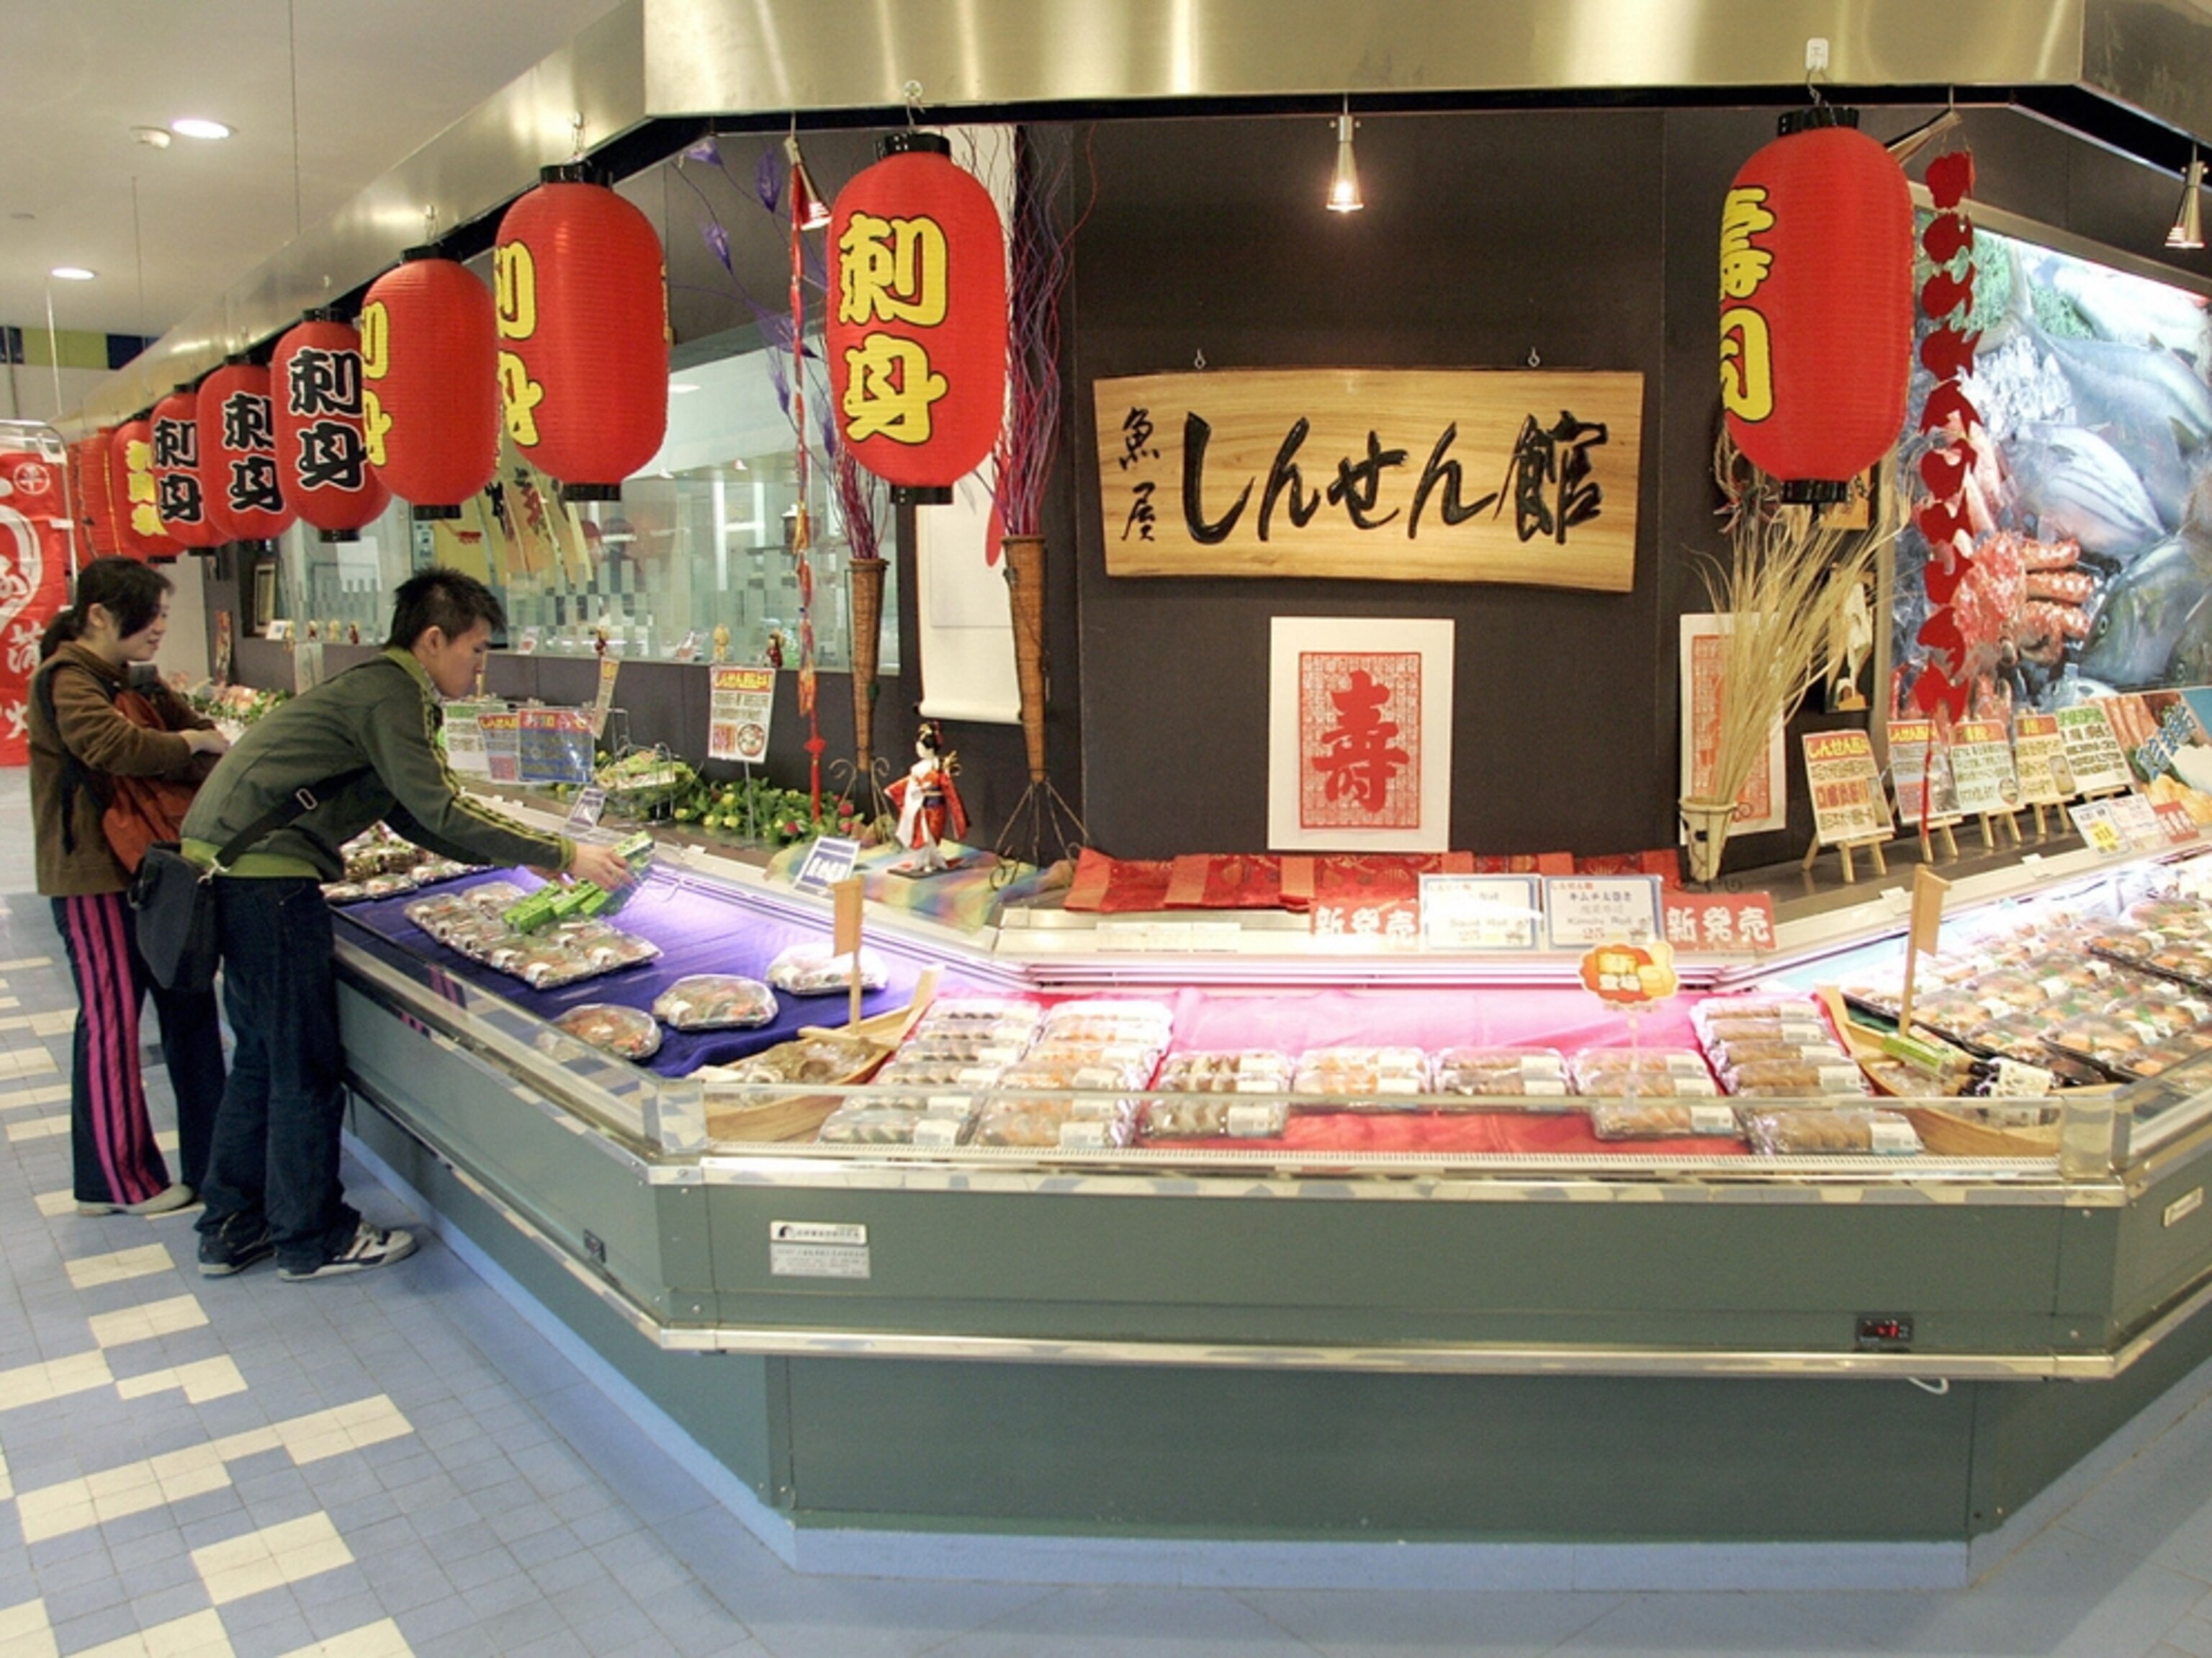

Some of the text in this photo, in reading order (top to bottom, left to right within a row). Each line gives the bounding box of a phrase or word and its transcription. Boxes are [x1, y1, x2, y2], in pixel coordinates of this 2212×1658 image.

[838, 210, 950, 447] 刺身
[152, 416, 205, 525] 刺身
[223, 390, 284, 513] 刺身
[289, 346, 367, 491] 刺身
[1117, 405, 1161, 542] 魚屋
[1181, 408, 1609, 546] しんせん館
[1665, 905, 1771, 944] 新発売
